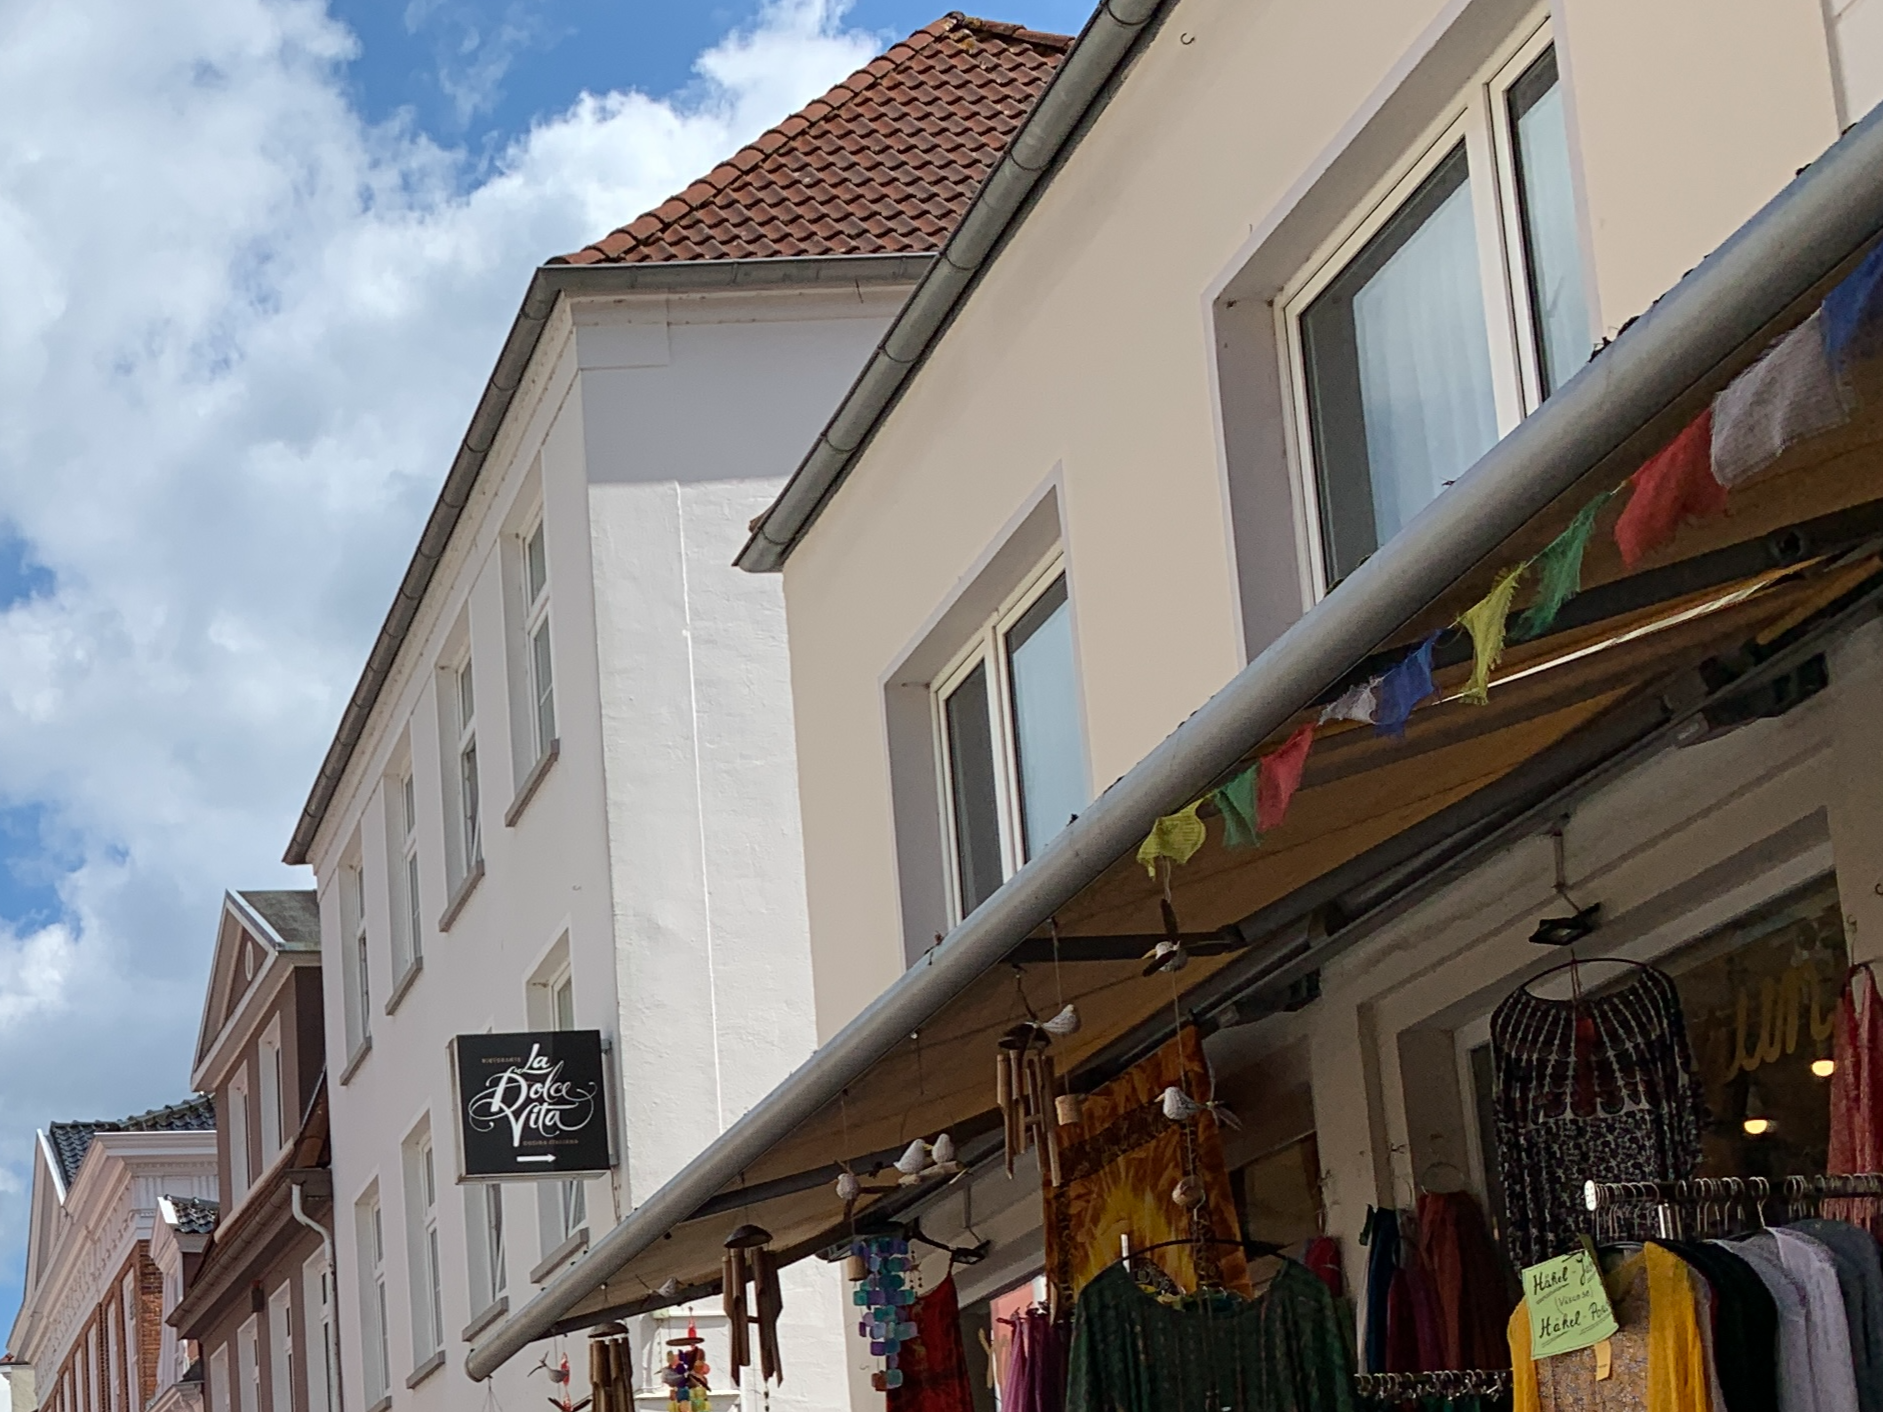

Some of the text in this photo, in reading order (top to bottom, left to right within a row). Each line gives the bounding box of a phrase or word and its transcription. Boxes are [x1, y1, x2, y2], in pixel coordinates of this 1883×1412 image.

[517, 1043, 554, 1074] La
[484, 1060, 594, 1113] Dolce
[486, 1101, 594, 1147] Vita
